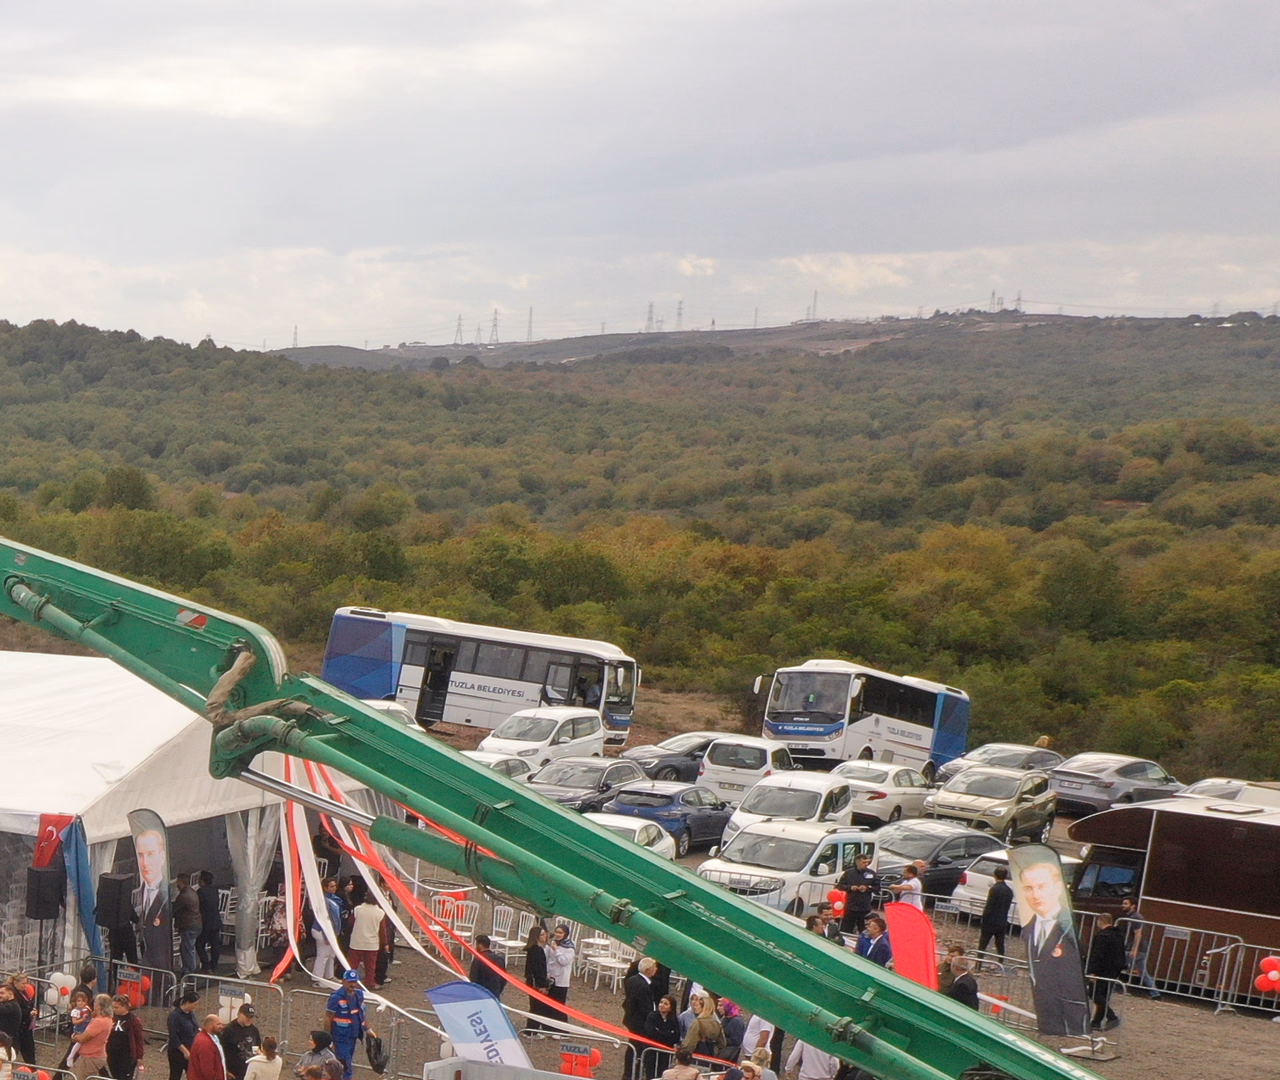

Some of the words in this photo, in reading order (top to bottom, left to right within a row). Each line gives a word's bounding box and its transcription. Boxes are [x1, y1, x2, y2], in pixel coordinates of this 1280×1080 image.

[449, 680, 475, 690] TUZLA
[477, 685, 524, 697] BELEDİYESİ
[560, 1044, 590, 1055] TUZLA
